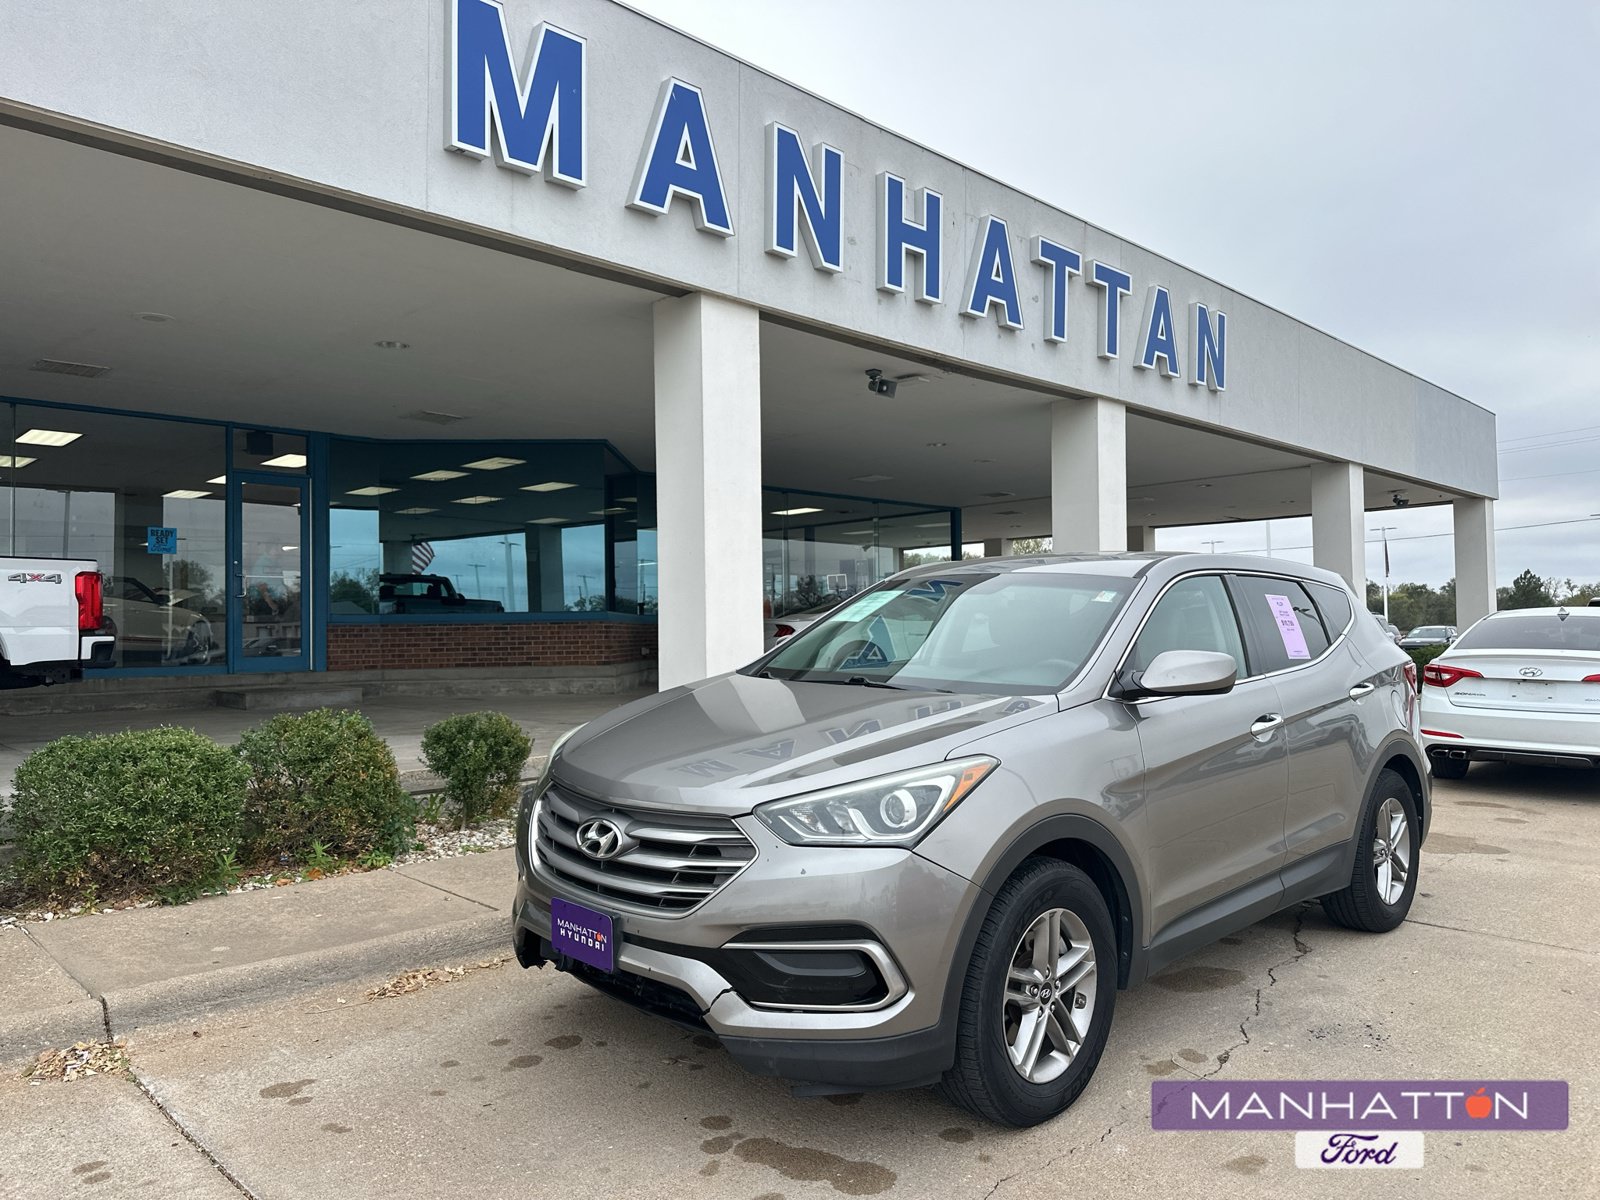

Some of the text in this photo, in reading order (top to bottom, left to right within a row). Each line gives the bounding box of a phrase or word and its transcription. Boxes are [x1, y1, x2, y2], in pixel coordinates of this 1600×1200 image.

[444, 0, 1228, 393] MANHATTAN
[150, 529, 174, 537] READY
[155, 536, 168, 544] SET
[560, 927, 605, 952] HYUNDAI
